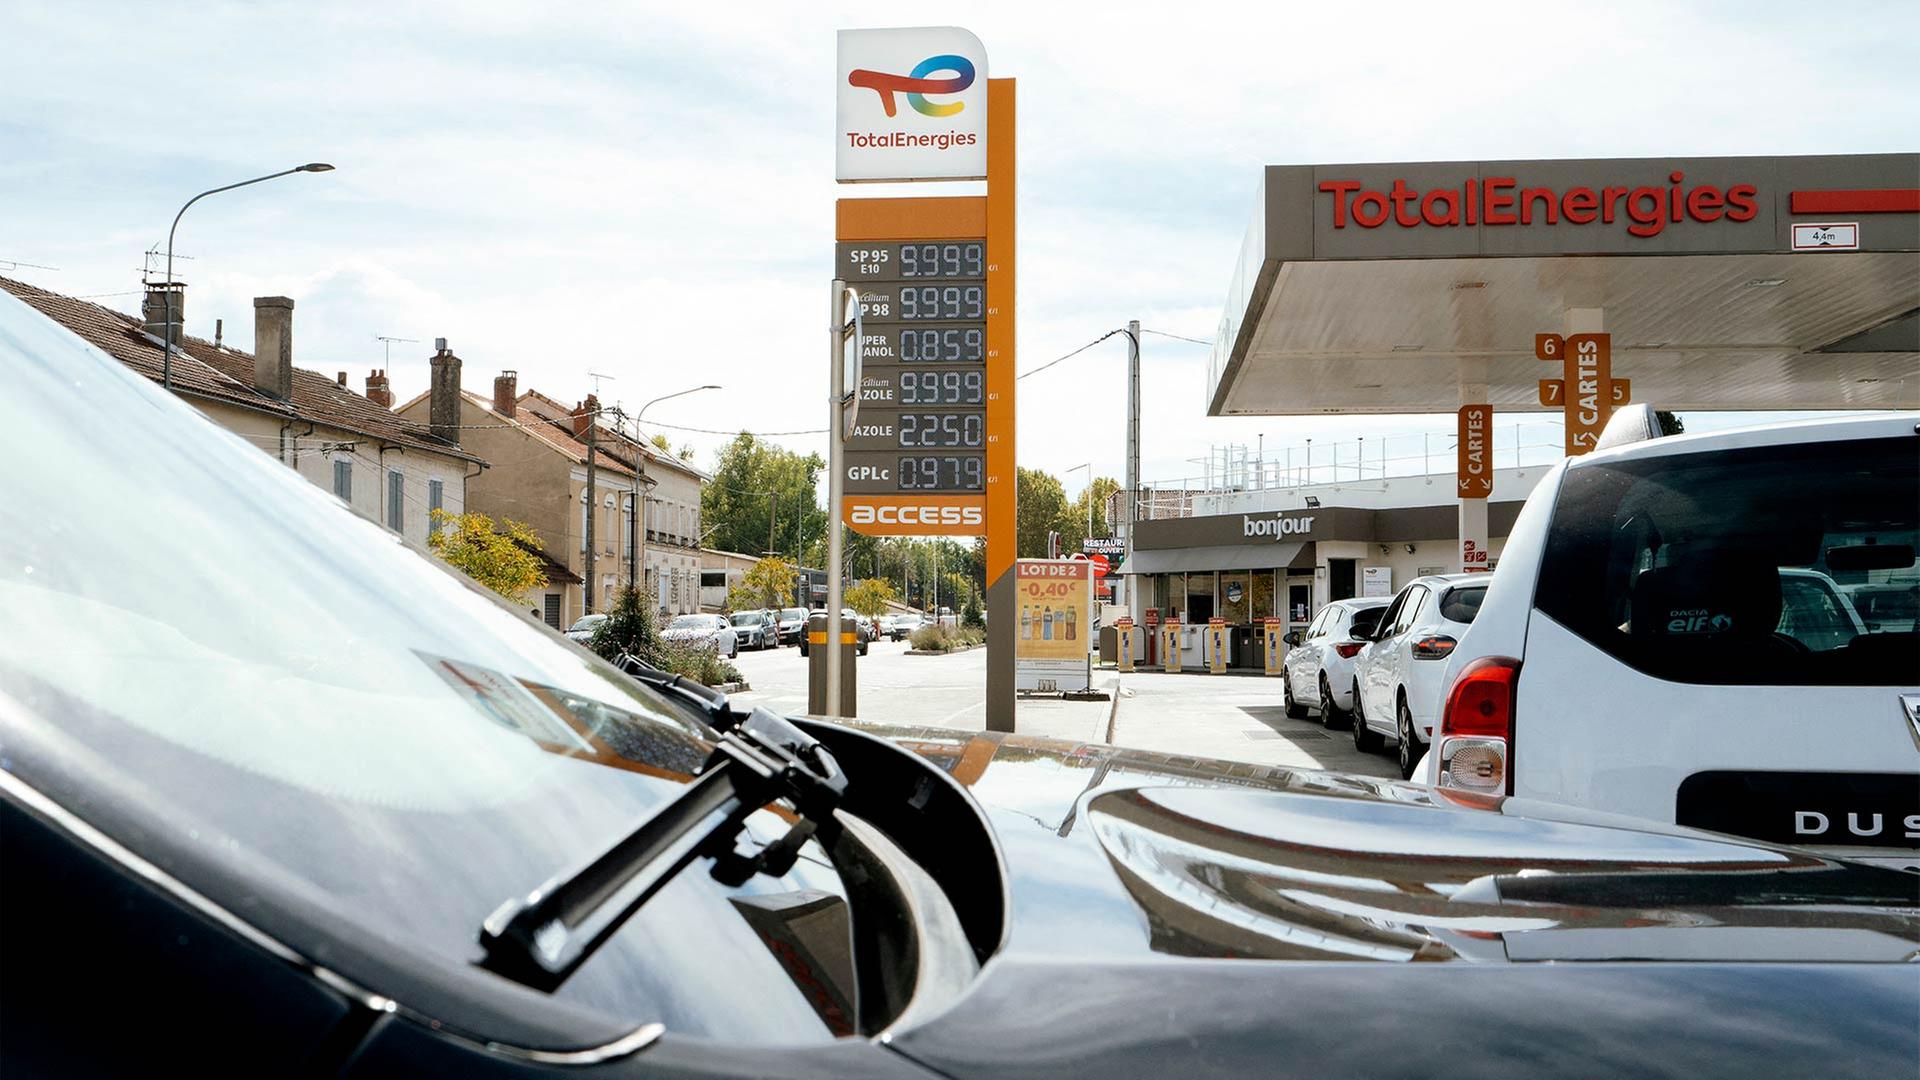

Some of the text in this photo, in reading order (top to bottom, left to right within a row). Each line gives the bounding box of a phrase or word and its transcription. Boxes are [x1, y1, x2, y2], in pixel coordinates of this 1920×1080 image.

[847, 130, 977, 150] TotalEnergies
[1319, 171, 1758, 238] TotalEnergies
[1813, 231, 1835, 241] 4,4m
[850, 250, 889, 263] SP 95
[901, 245, 982, 276] 9.999
[861, 264, 880, 274] E10
[872, 304, 889, 316] 98
[901, 287, 982, 318] 9.999
[901, 330, 982, 361] 0.859
[1544, 339, 1555, 355] 6
[901, 372, 982, 403] 9.999
[1578, 340, 1598, 425] CARTES
[1548, 384, 1558, 400] 7
[1613, 386, 1623, 400] 5
[853, 426, 893, 437] AZOLE
[900, 415, 982, 446] 2.250
[1468, 410, 1483, 475] CARTES
[848, 466, 889, 481] GPLc
[900, 457, 982, 489] 0.979
[851, 505, 982, 525] access
[1244, 512, 1315, 541] bonjour
[1021, 565, 1077, 576] LOT DE 2
[1670, 609, 1708, 617] DACIA
[1667, 617, 1707, 632] elf
